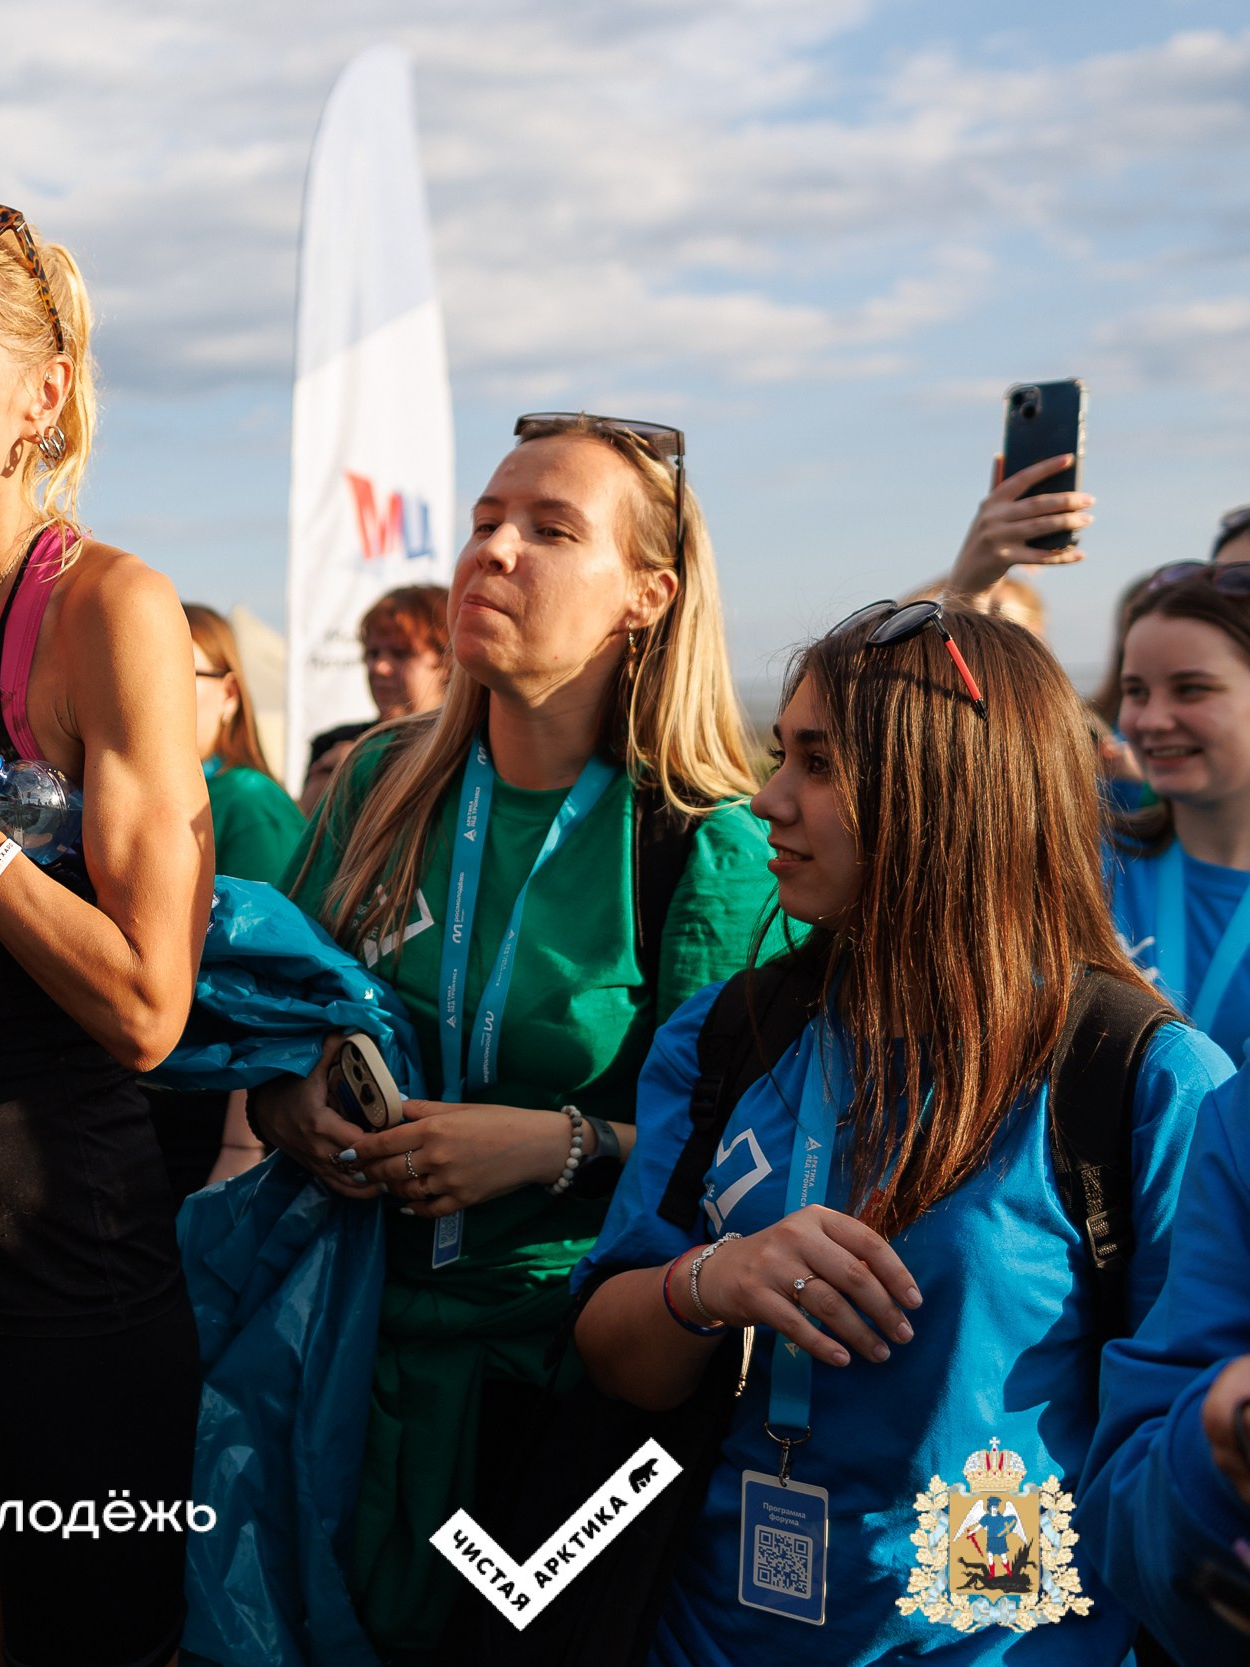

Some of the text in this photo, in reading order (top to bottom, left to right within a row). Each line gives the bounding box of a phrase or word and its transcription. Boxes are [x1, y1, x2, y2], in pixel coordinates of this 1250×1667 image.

[809, 1154, 818, 1187] АРКТИКА
[762, 1501, 806, 1519] Программа
[768, 1512, 799, 1526] форума
